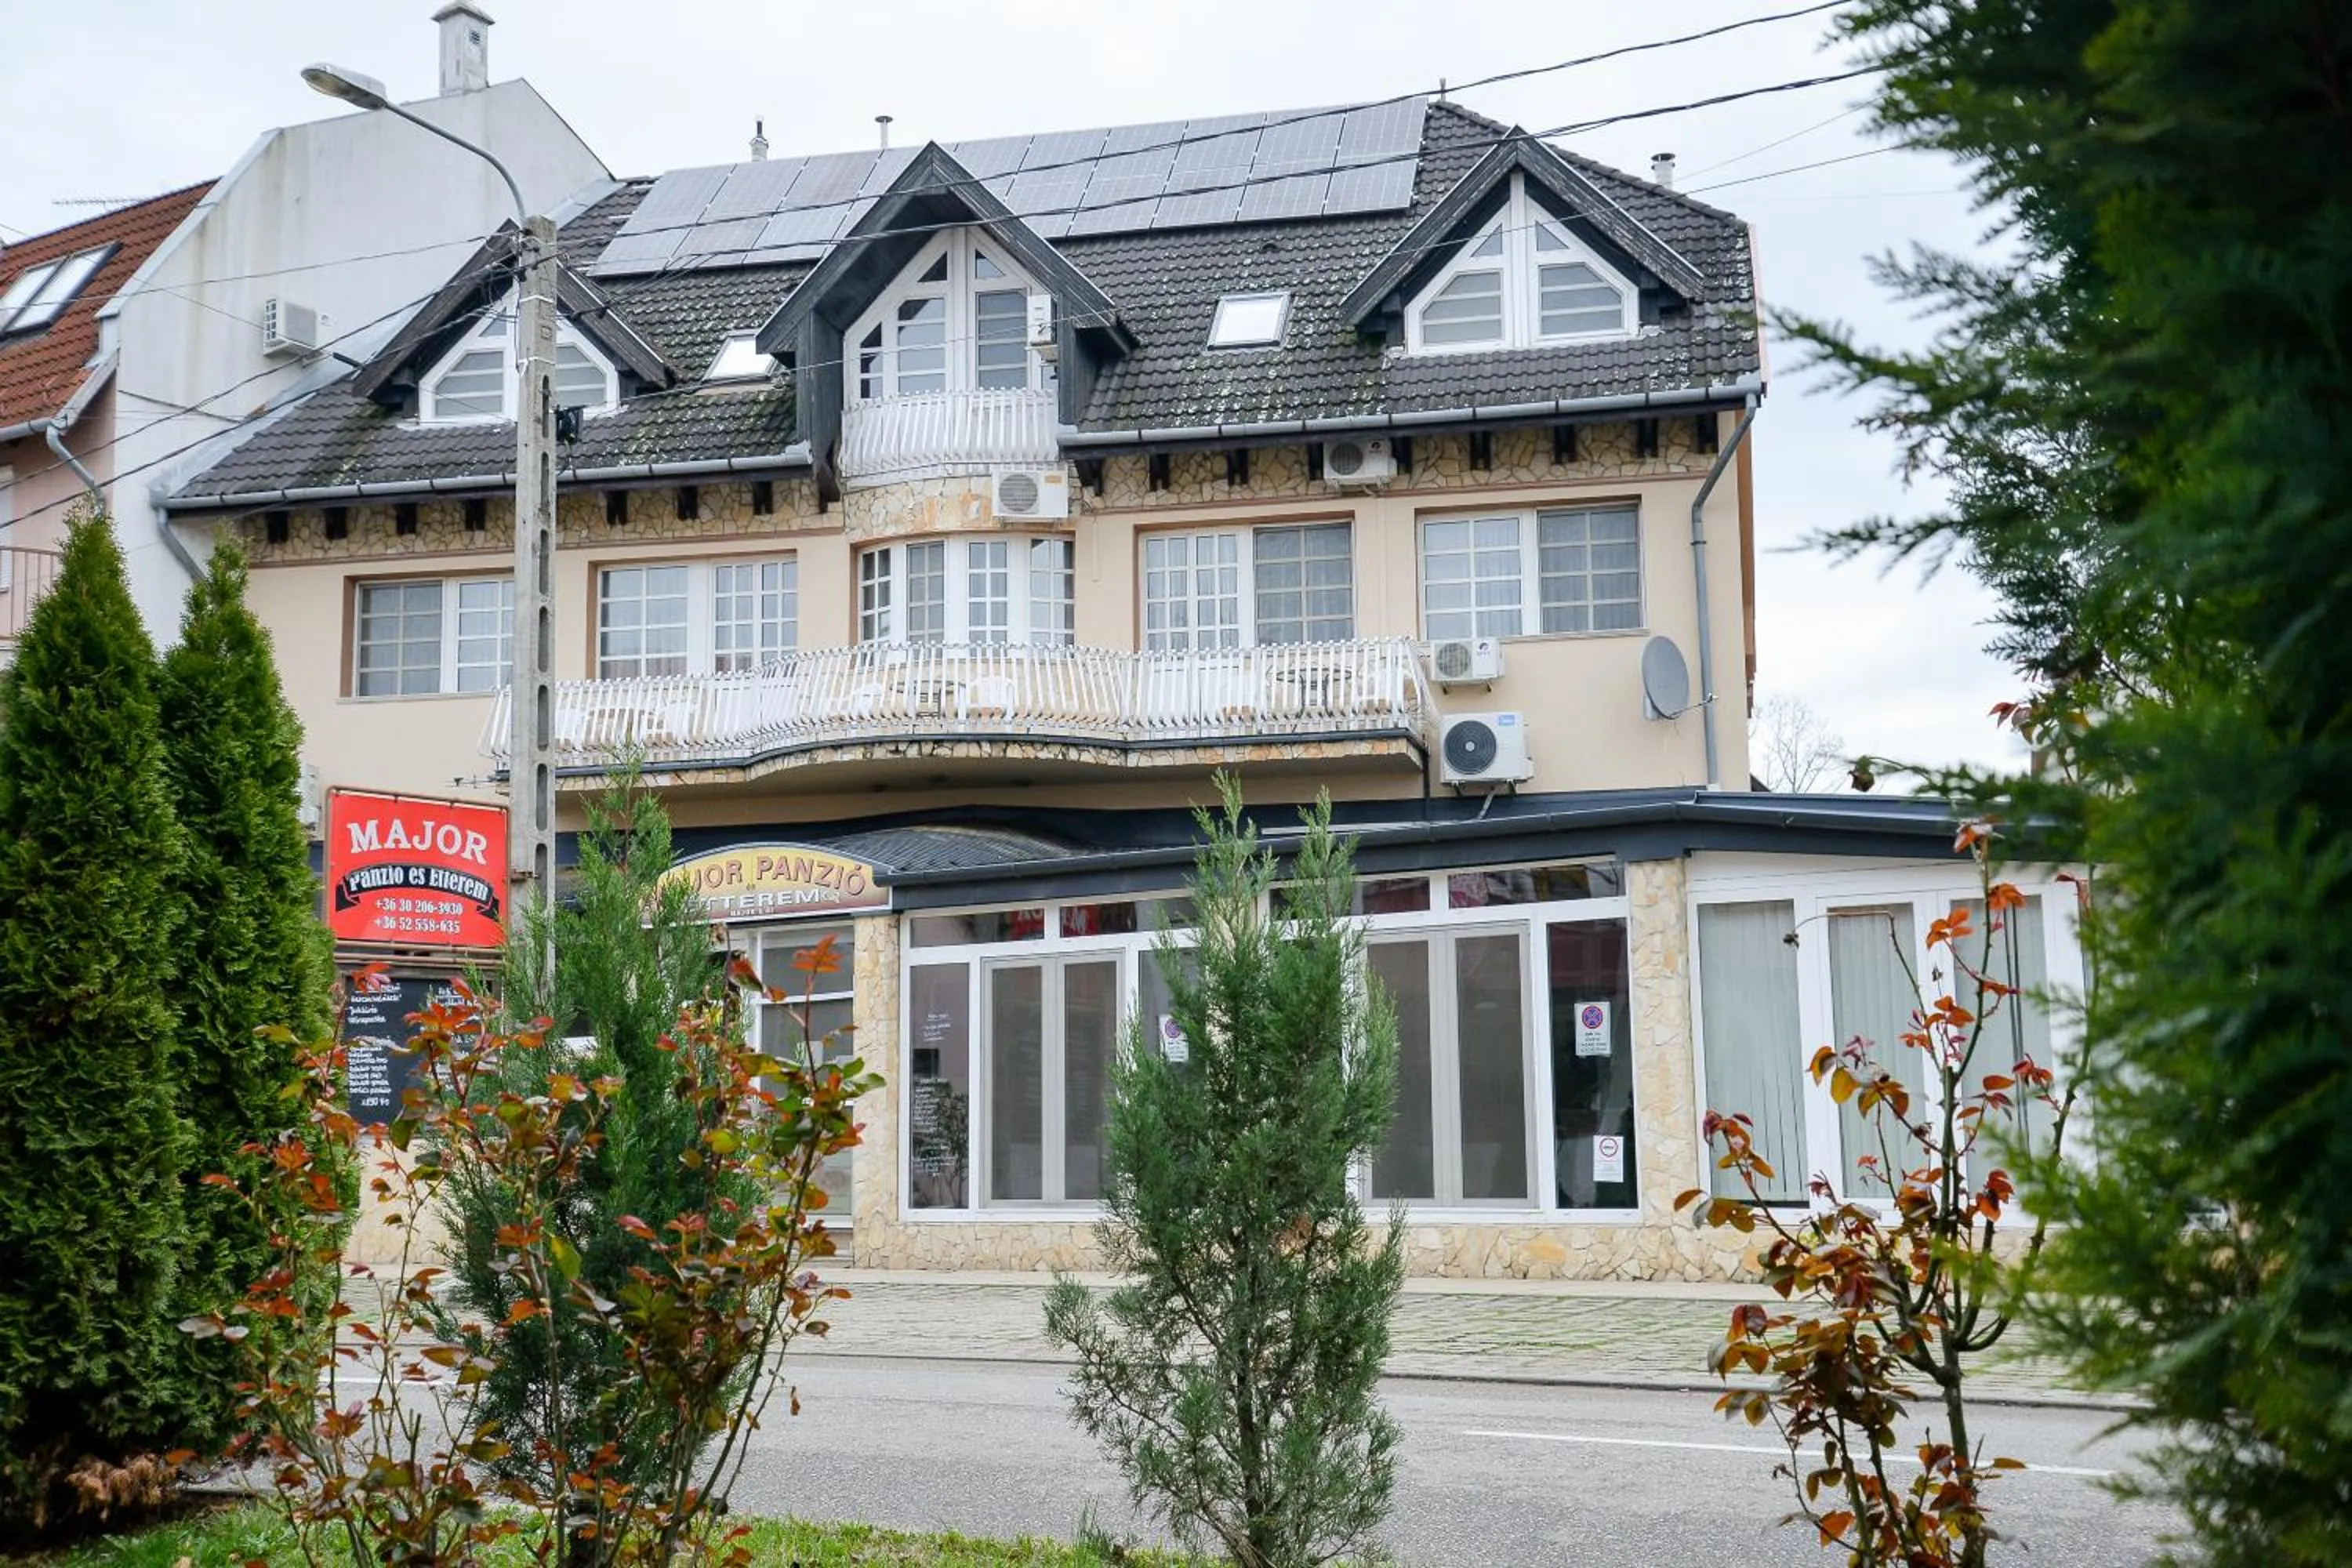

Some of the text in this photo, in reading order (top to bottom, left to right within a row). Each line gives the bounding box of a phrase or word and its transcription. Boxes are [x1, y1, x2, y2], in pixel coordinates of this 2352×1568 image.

[347, 818, 488, 865] MAJOR
[757, 856, 866, 895] PANZIÓ
[376, 898, 396, 910] +36
[399, 898, 412, 912] 30
[376, 916, 396, 929] +36
[399, 916, 412, 931] 52
